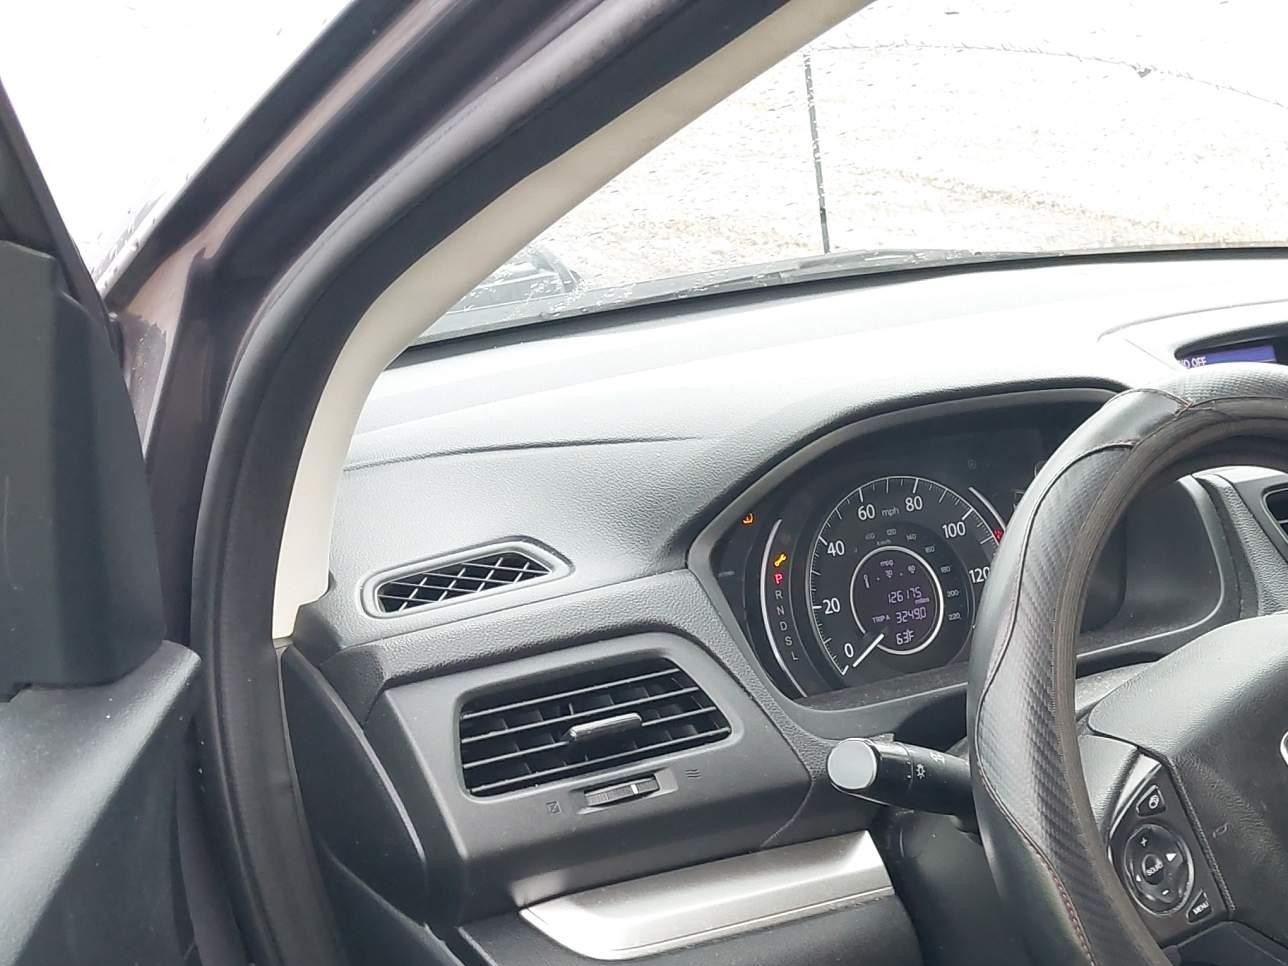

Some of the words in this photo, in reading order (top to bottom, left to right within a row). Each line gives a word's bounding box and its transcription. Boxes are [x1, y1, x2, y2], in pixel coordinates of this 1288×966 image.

[905, 496, 923, 511] 80
[858, 504, 875, 521] 60
[881, 507, 900, 517] mph
[942, 521, 966, 539] 100
[827, 540, 845, 557] 40
[774, 573, 783, 584] P
[775, 590, 783, 600] R
[776, 605, 785, 615] N
[822, 597, 841, 615] 20
[780, 621, 788, 631] D
[784, 636, 793, 646] S
[791, 651, 799, 660] L
[844, 642, 854, 658] 0
[1192, 901, 1210, 915] MENU
